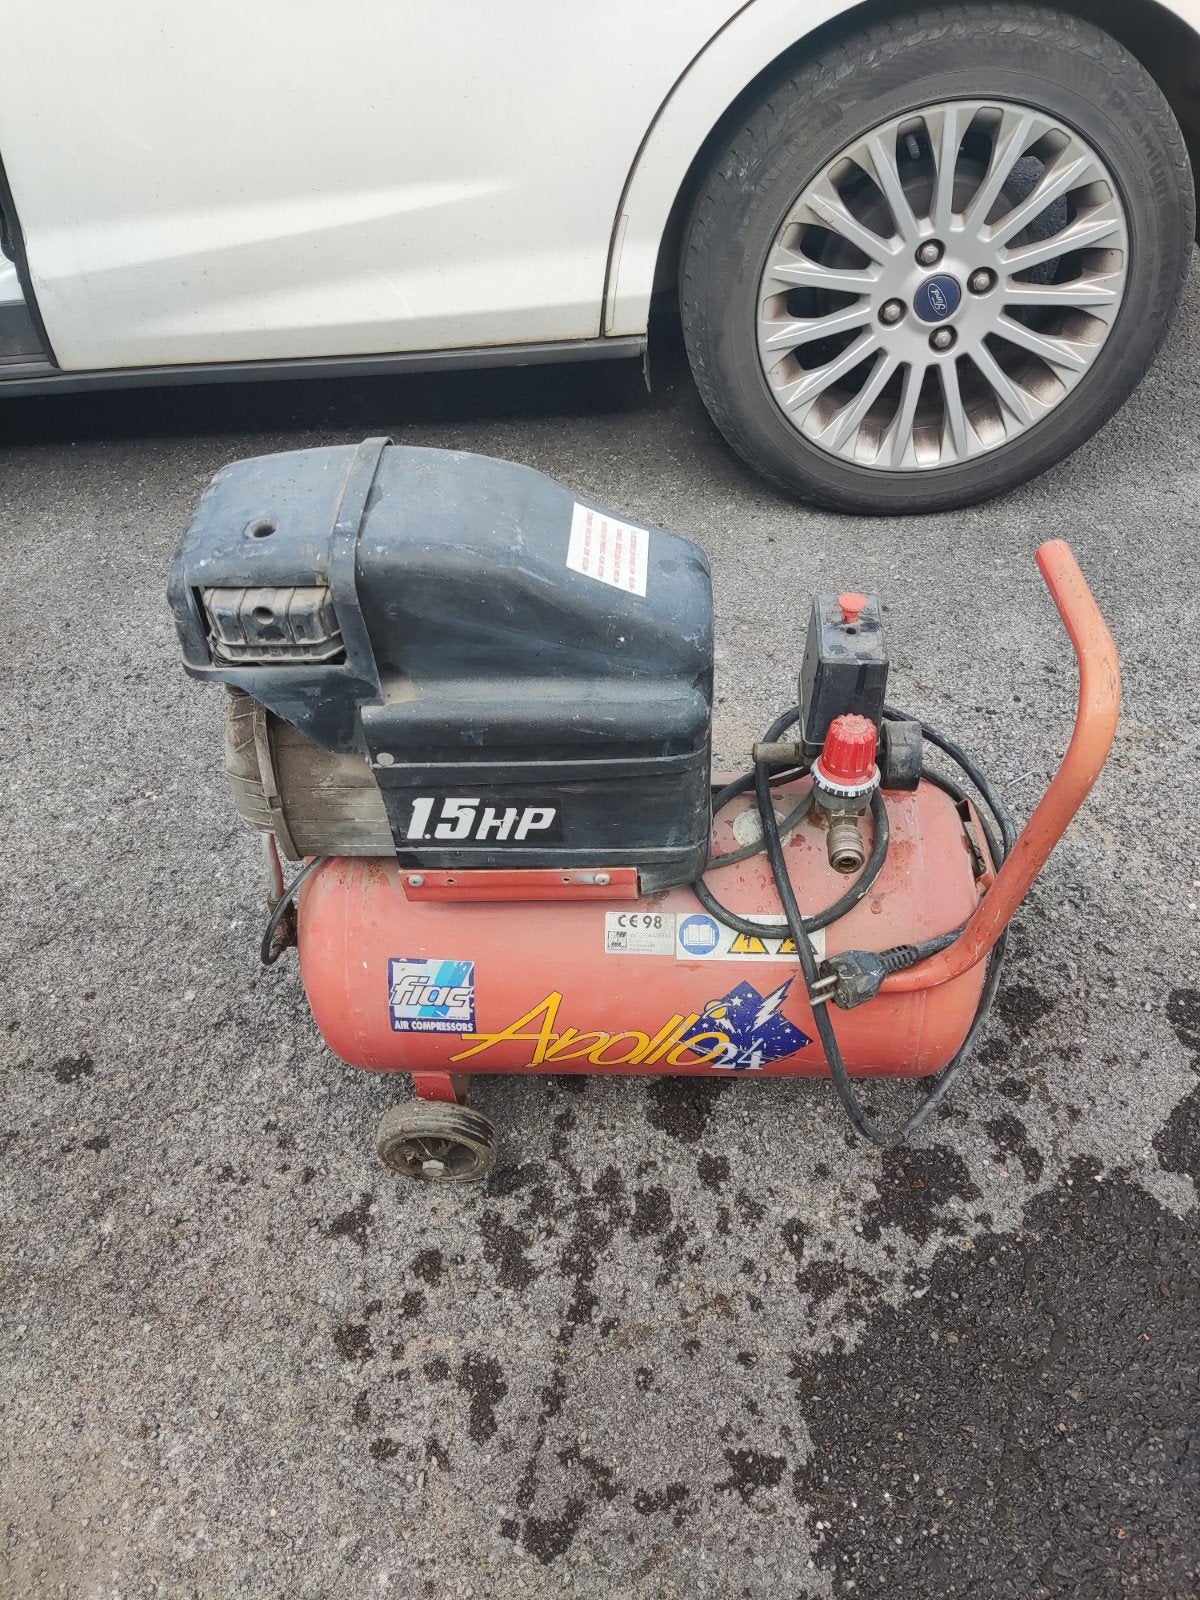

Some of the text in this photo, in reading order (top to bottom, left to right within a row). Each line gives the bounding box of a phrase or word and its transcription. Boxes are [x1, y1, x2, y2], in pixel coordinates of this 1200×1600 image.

[931, 288, 946, 310] Ford
[642, 915, 663, 930] 98
[390, 975, 474, 1007] fiac
[394, 1020, 474, 1033] AIR COMPRESSORS
[448, 990, 731, 1068] Apollo
[709, 1037, 766, 1070] 24
